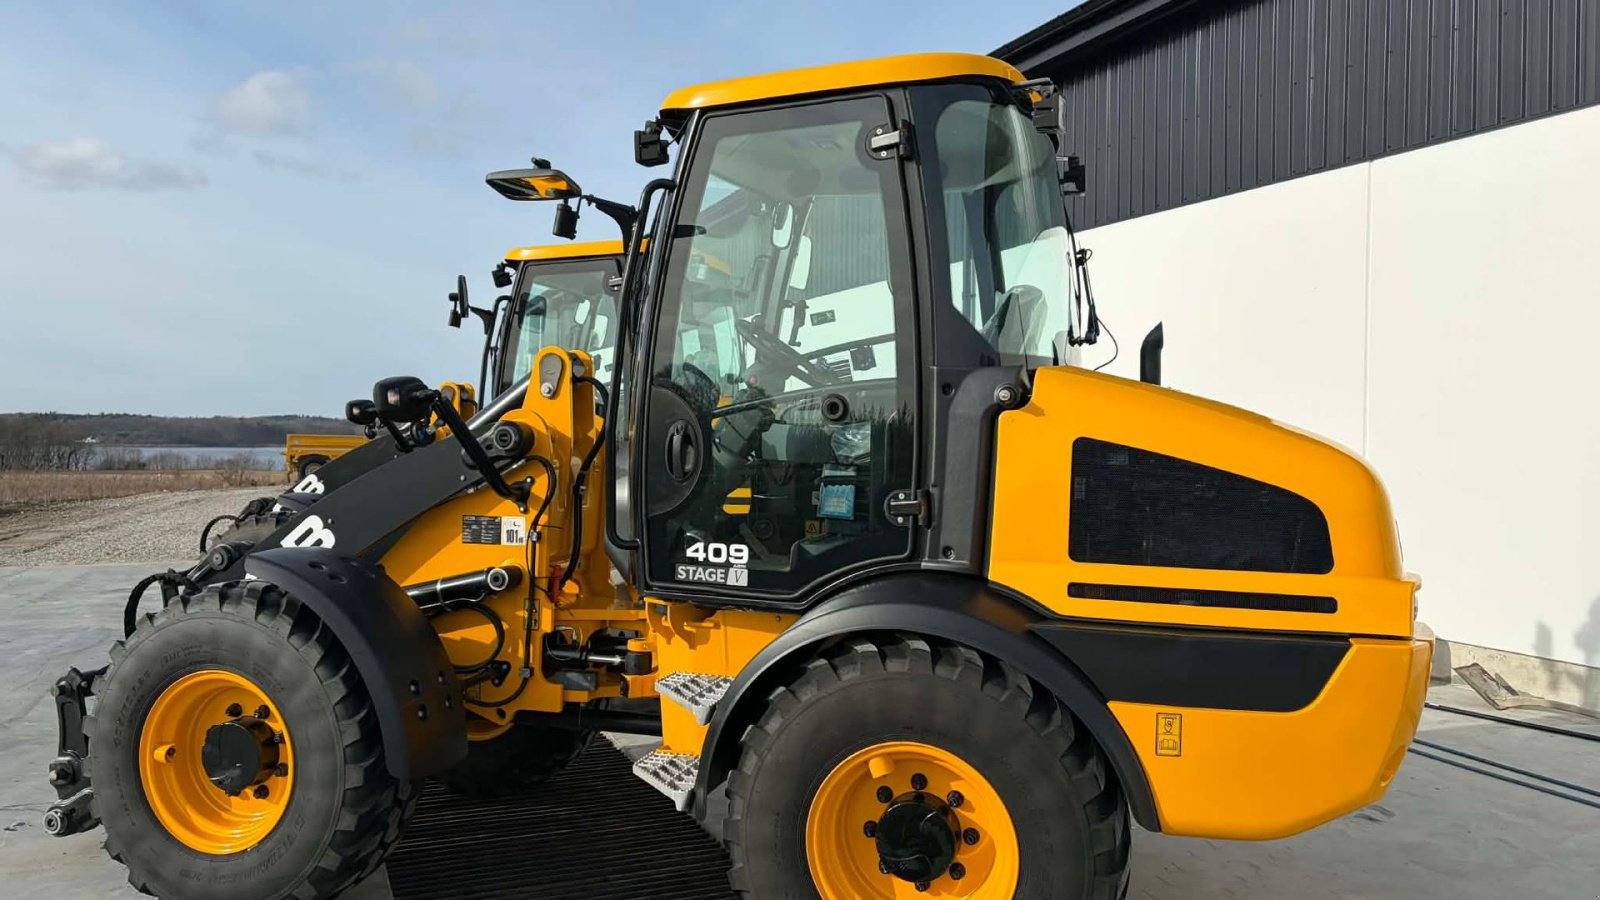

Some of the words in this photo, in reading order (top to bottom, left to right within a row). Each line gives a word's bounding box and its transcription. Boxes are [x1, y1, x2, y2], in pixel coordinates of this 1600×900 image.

[506, 529, 519, 544] 101
[686, 542, 749, 564] 409
[677, 565, 726, 583] STAGE
[734, 570, 745, 583] V
